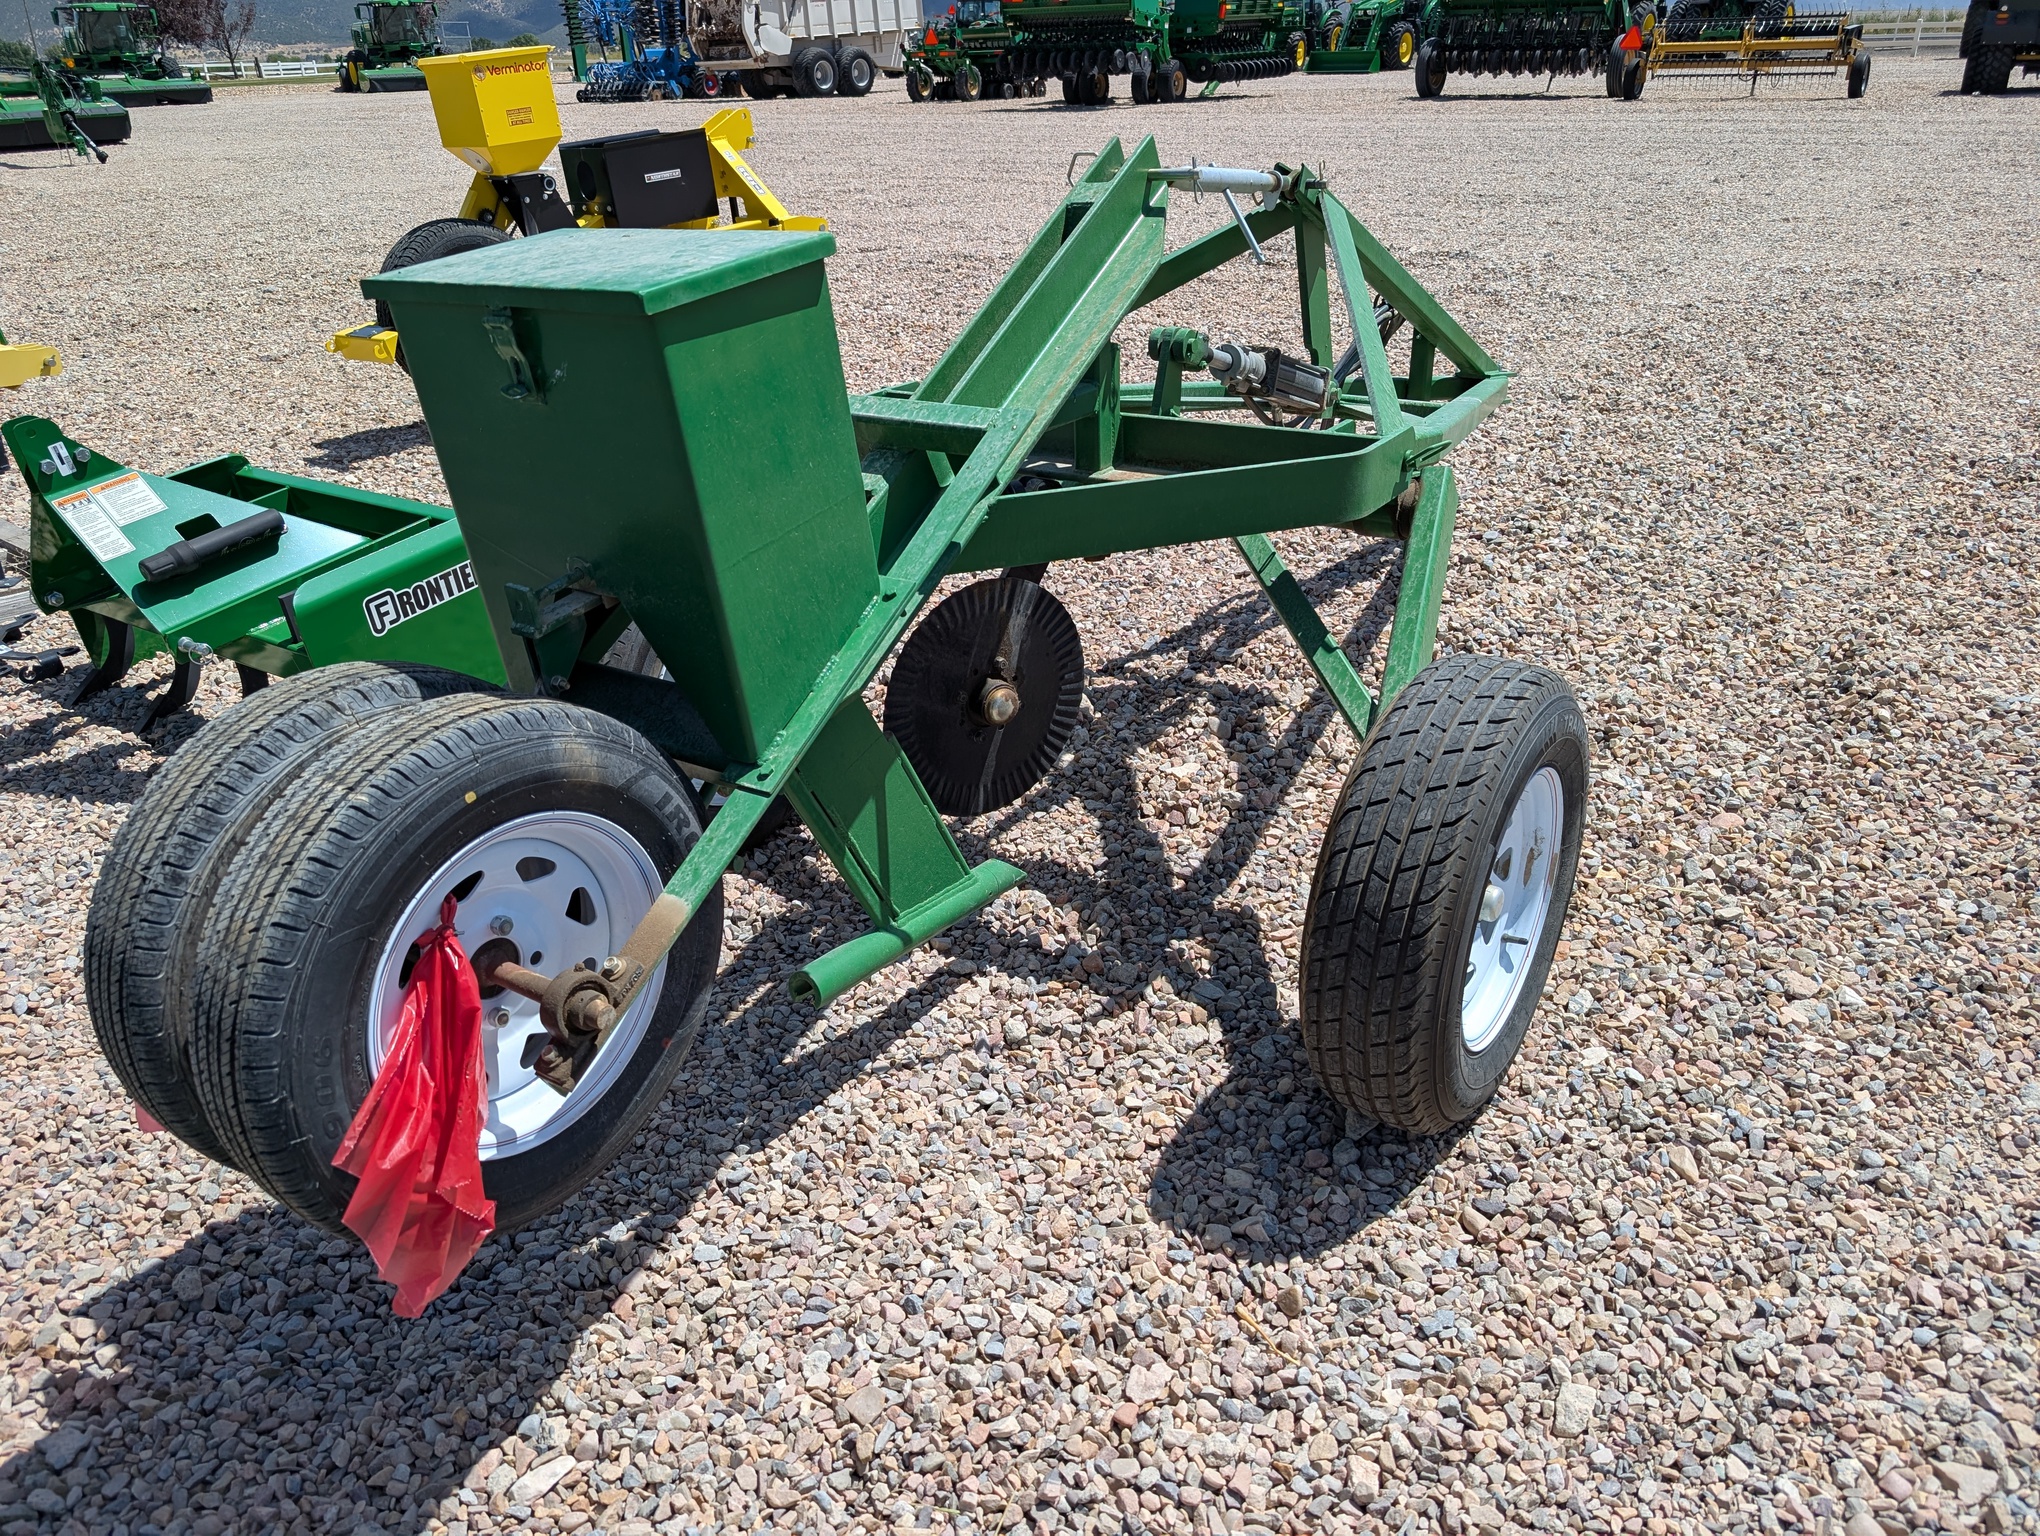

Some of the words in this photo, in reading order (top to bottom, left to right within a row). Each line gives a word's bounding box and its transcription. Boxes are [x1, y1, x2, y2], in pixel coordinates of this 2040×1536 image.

[486, 61, 545, 76] Verminator
[105, 477, 130, 490] WARNING
[62, 493, 87, 504] WARNING
